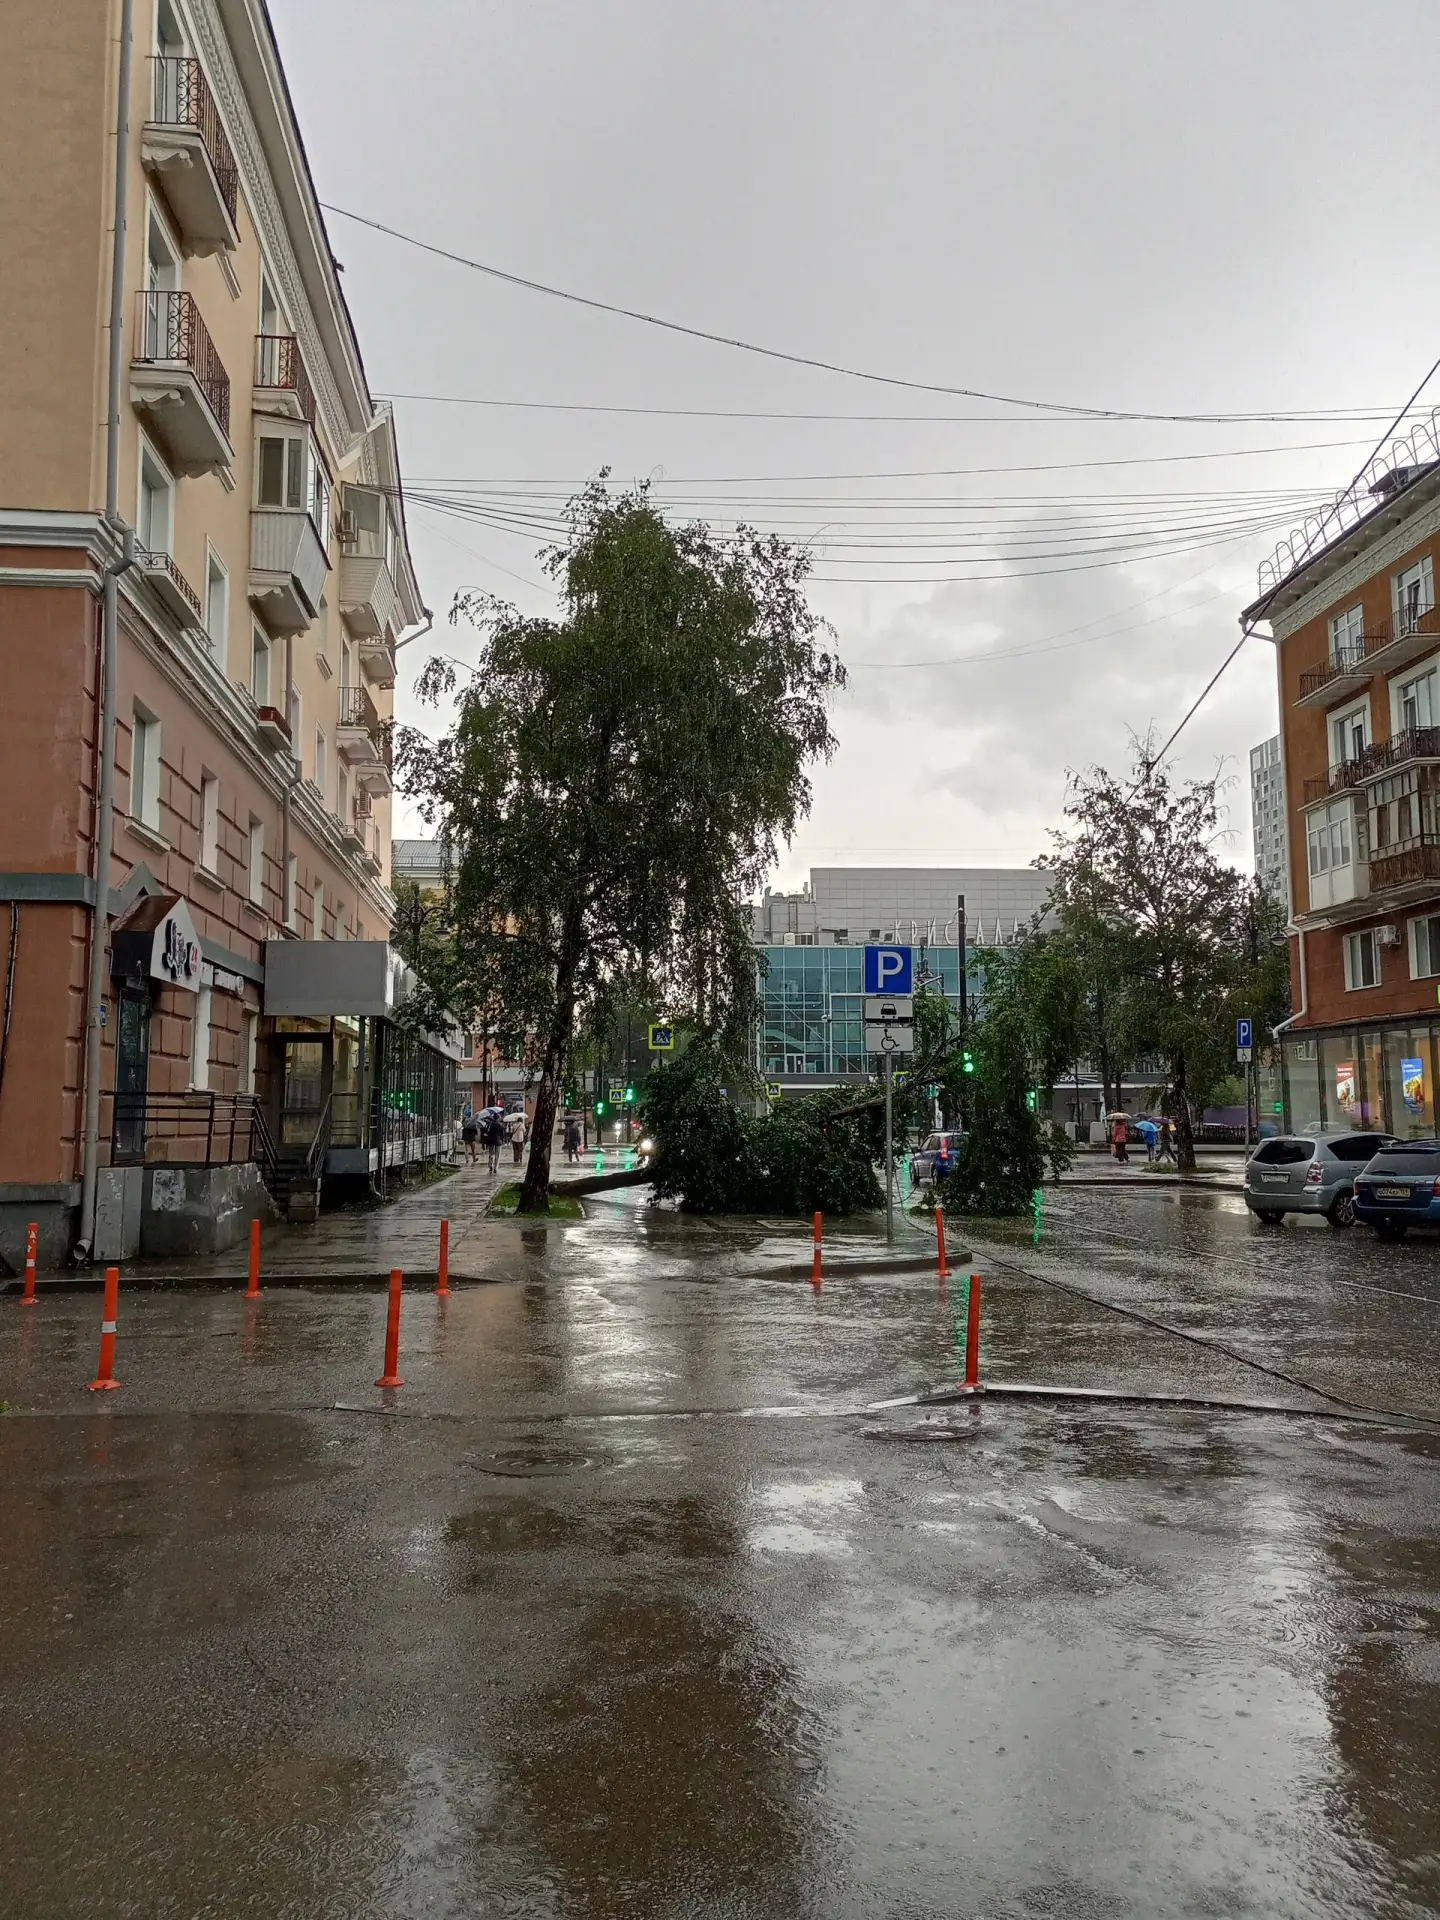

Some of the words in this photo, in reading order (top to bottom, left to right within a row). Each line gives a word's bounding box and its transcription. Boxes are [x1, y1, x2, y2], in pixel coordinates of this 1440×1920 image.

[894, 916, 1020, 949] КРИСАЛЛ
[877, 951, 904, 989] P
[1240, 1022, 1249, 1044] P
